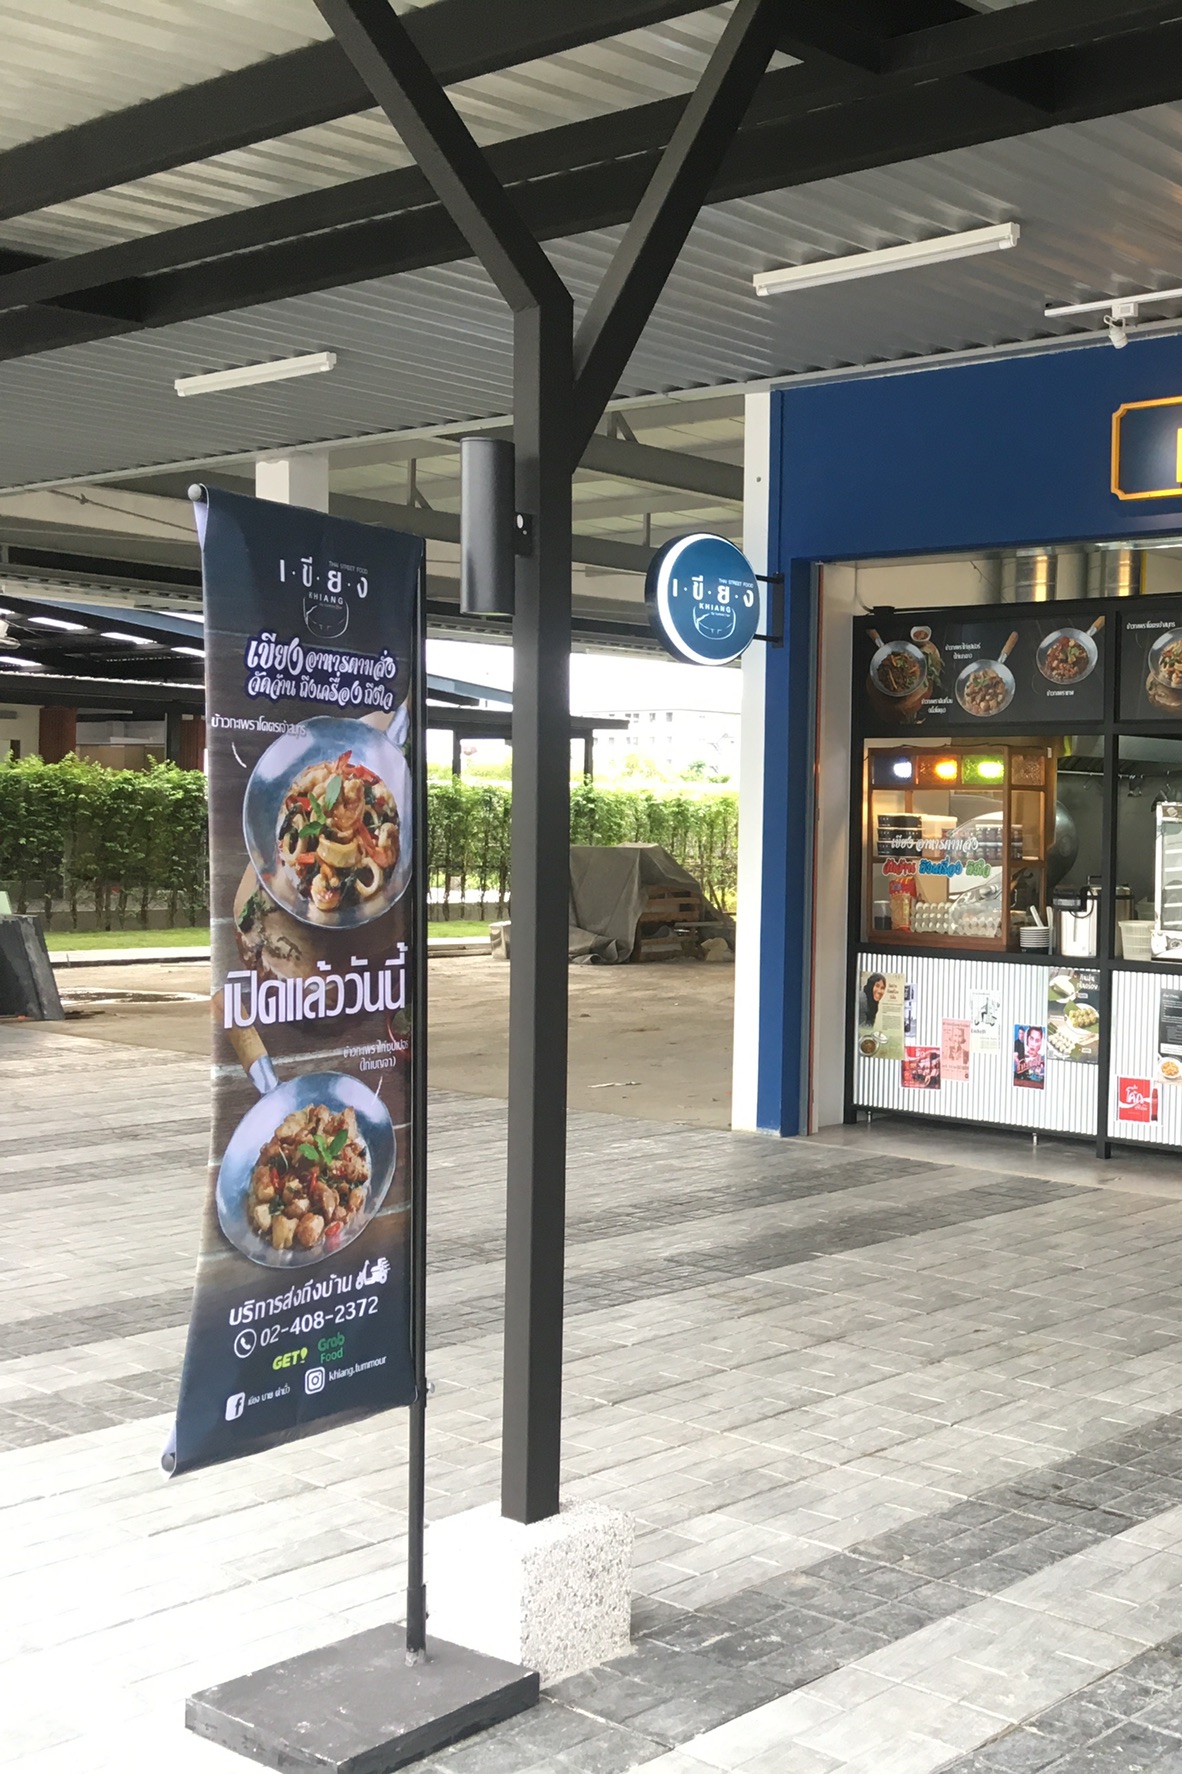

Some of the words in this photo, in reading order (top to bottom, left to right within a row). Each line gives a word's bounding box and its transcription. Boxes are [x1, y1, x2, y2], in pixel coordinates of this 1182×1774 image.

[308, 591, 344, 605] KHIANG
[698, 602, 731, 613] KHIANG
[247, 632, 304, 675] เขียง
[305, 650, 396, 681] อาหารตามสั่ง
[248, 671, 296, 700] จัดจ้าน
[299, 672, 362, 706] ถึงเครื่อง
[224, 942, 409, 1029] เปิดแล้ววันนี้
[228, 1273, 354, 1326] บริการส่งถึงบ้าน
[260, 1296, 379, 1347] 02-408-2372
[318, 1332, 345, 1352] Grab
[320, 1348, 344, 1364] Food
[328, 1355, 387, 1382] khiang.tummour
